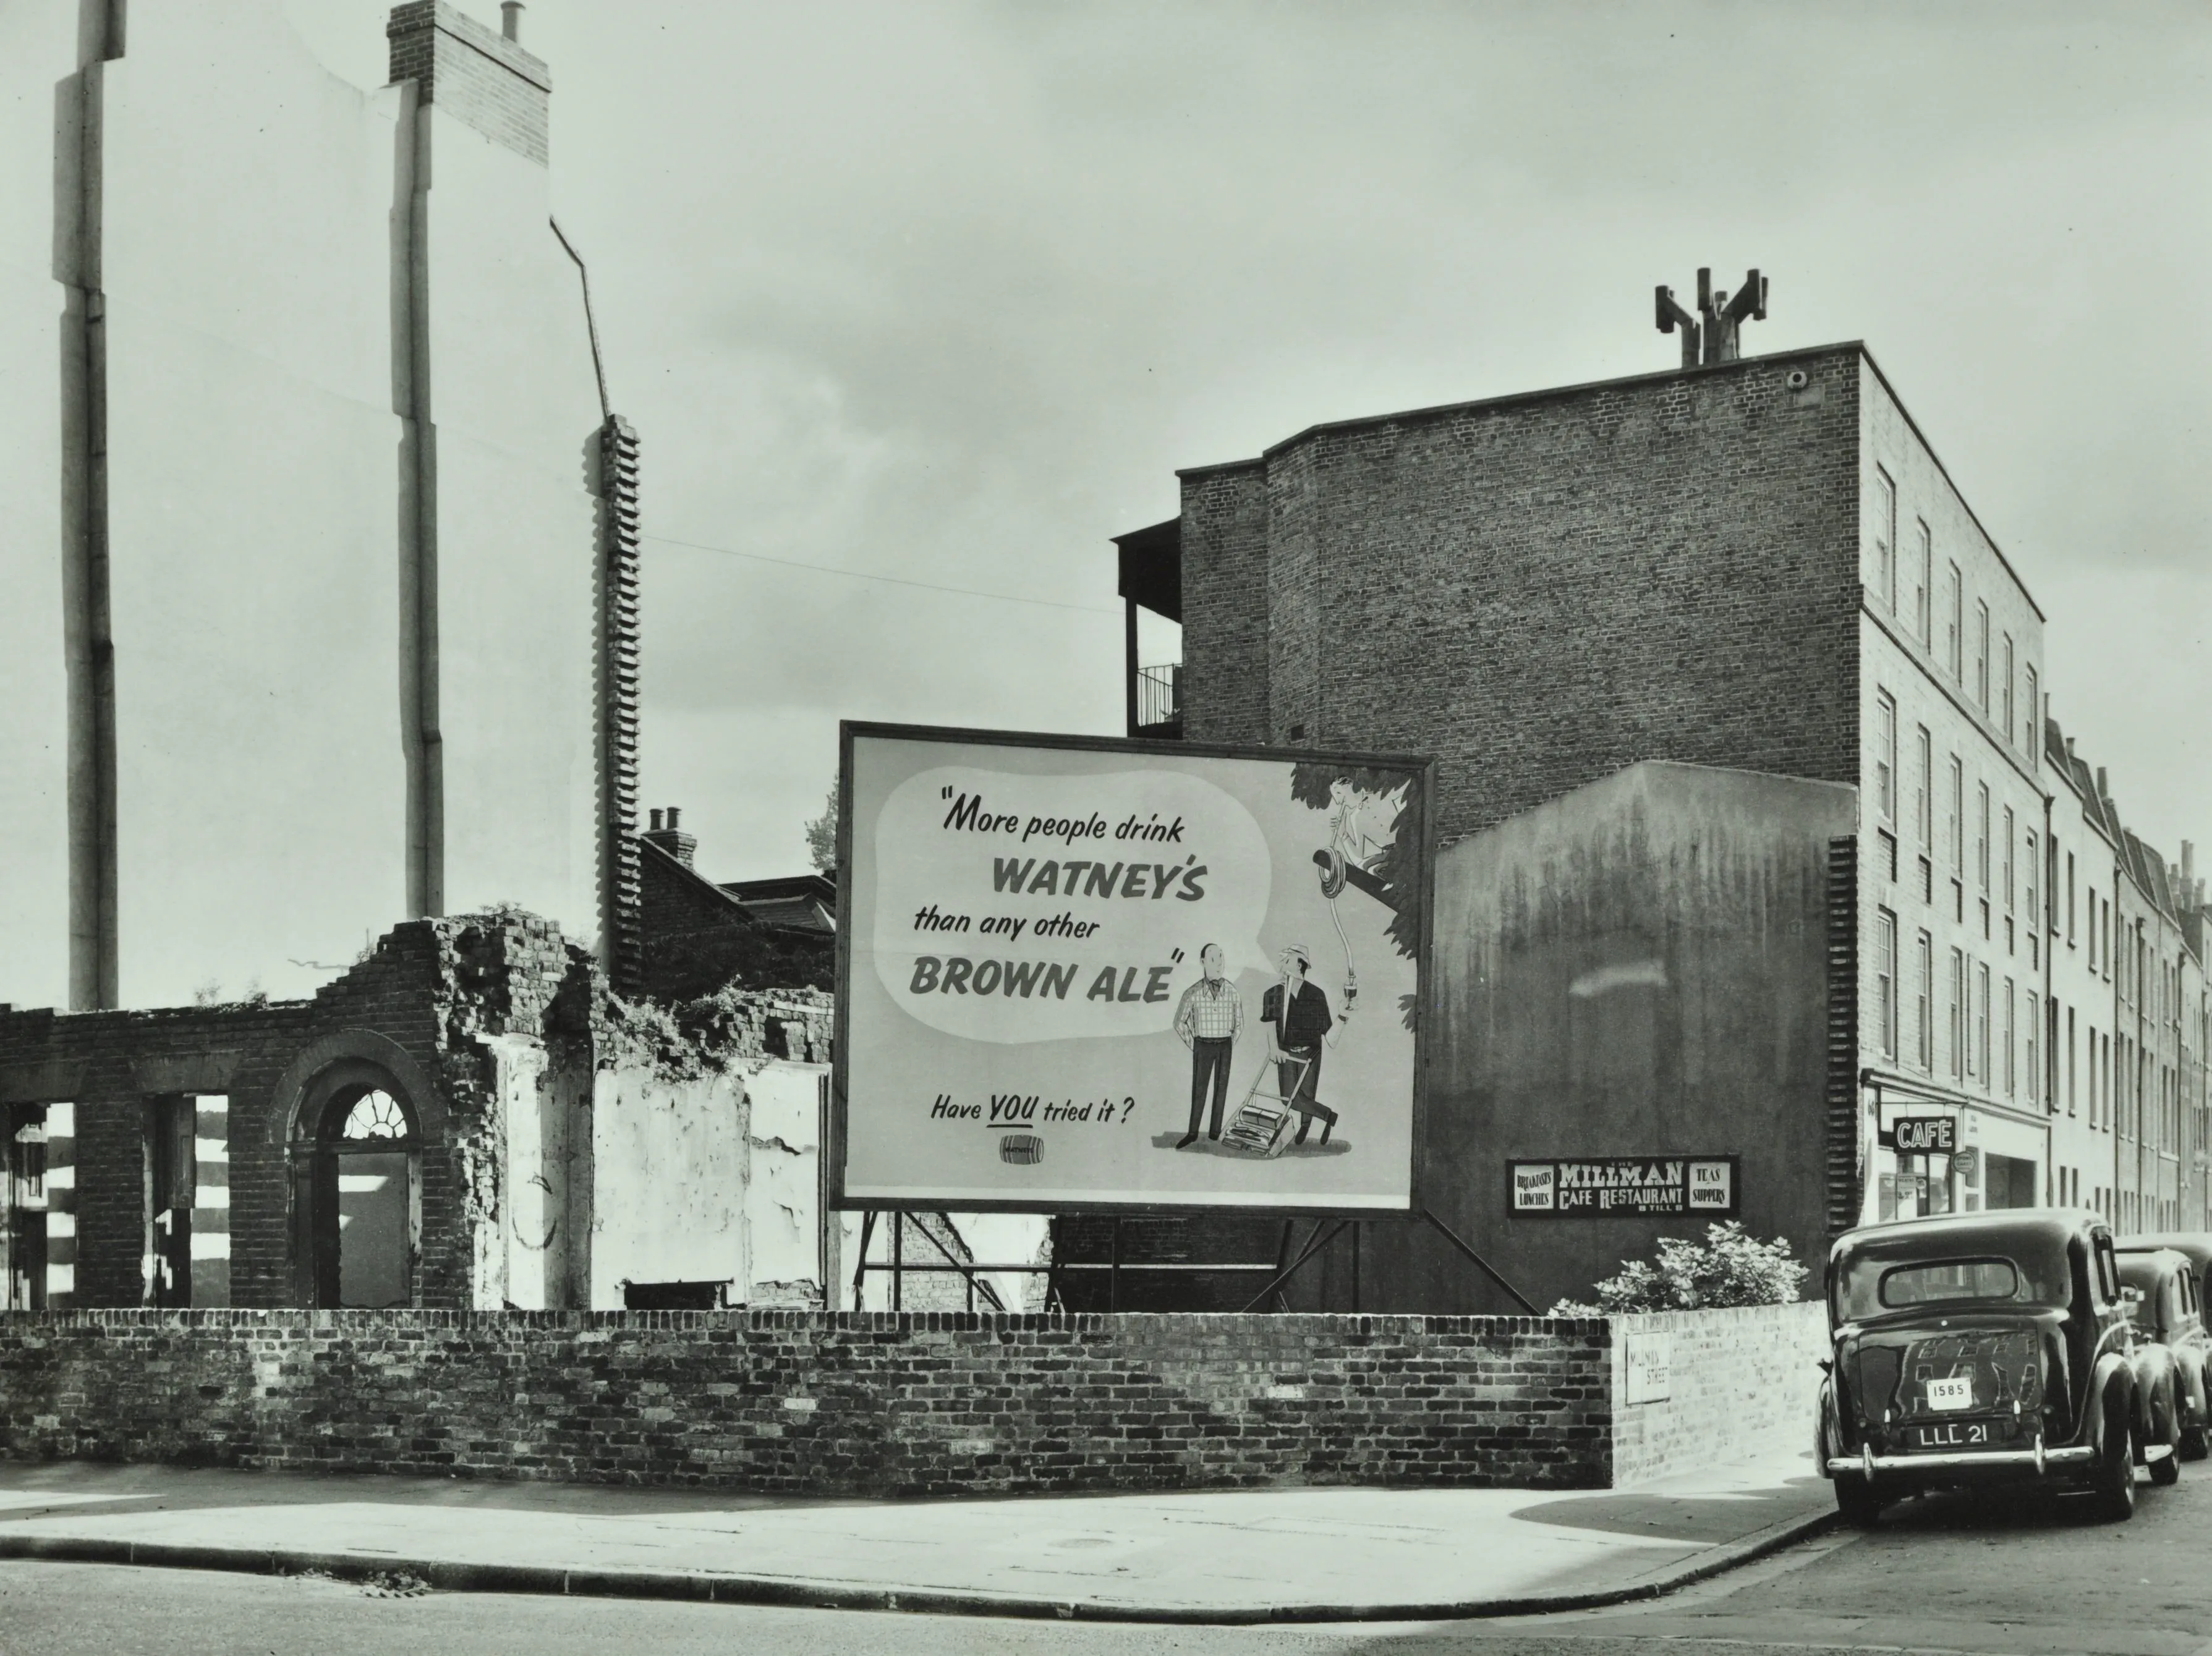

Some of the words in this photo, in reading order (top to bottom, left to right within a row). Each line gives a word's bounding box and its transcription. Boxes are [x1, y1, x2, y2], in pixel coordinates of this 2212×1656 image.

[1022, 812, 1106, 846] people
[1115, 813, 1185, 843] drink
[994, 854, 1207, 901] WATNEY'S
[914, 905, 970, 932] than
[980, 917, 1027, 941] any
[1034, 912, 1100, 938] other
[910, 956, 1078, 1000] BROWN
[931, 1094, 982, 1119] Have
[990, 1095, 1040, 1121] YOU
[1044, 1100, 1093, 1121] tried
[1517, 1171, 1552, 1192] BREAKFASTS
[1559, 1161, 1683, 1188] MILLMAN
[1696, 1168, 1721, 1183] TEAS
[1520, 1192, 1549, 1205] LUNCHES
[1559, 1189, 1593, 1210] CAFE
[1599, 1187, 1683, 1209] RESTAURANT
[1693, 1188, 1725, 1204] SUPPERS
[1934, 1384, 1964, 1397] 1585
[1968, 1424, 1988, 1443] 21
